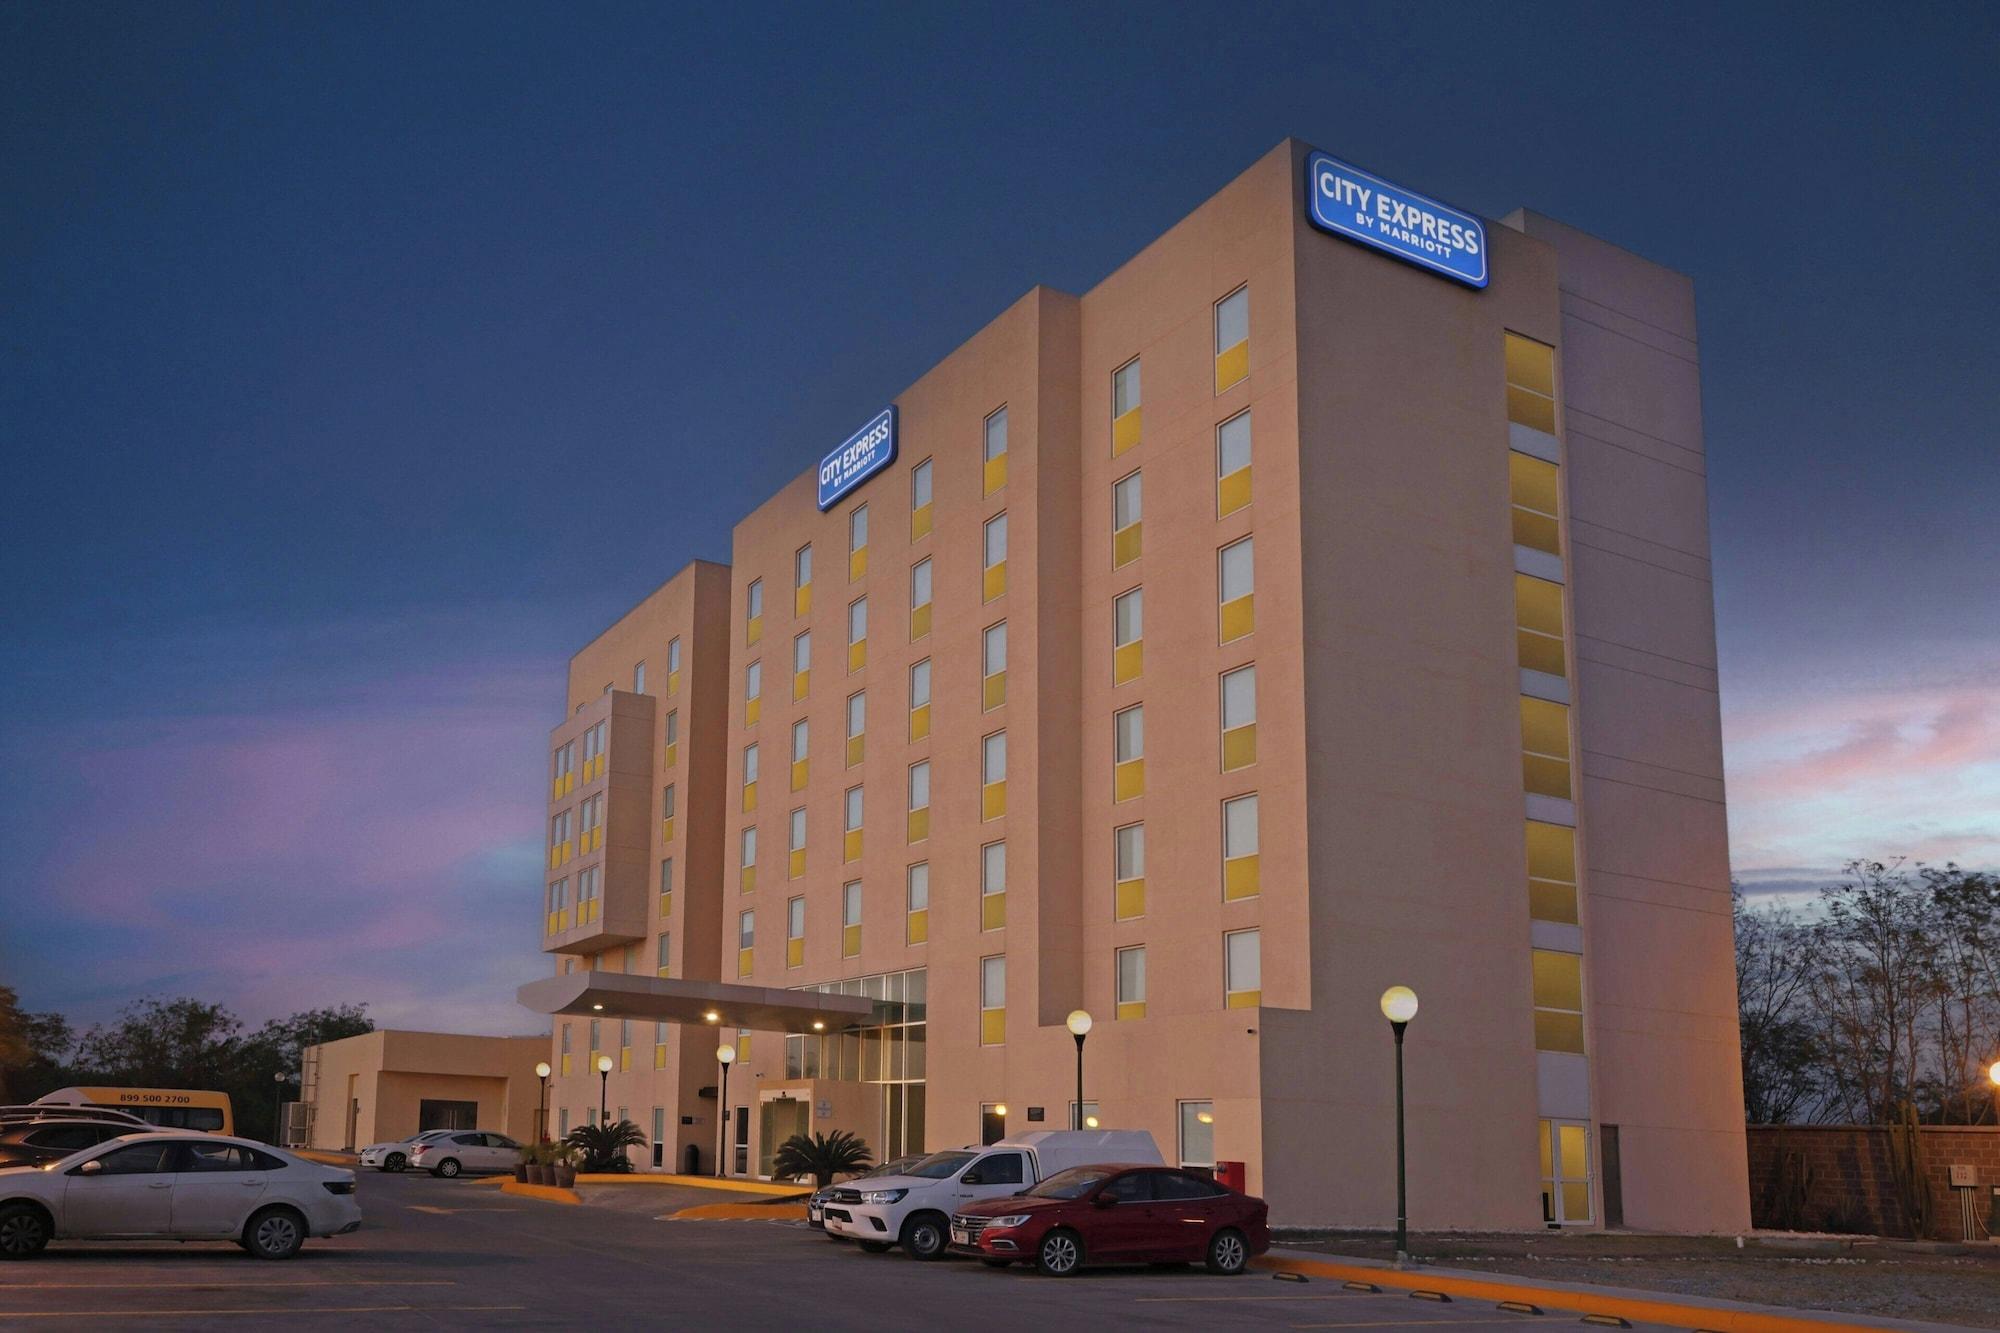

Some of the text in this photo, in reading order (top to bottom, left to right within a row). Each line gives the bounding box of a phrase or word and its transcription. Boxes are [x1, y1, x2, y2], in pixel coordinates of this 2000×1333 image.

[1320, 172, 1479, 255] CITY EXPRESS
[1356, 212, 1452, 259] BY MARRIOTT
[821, 419, 889, 485] CITY EXPRESS
[833, 450, 876, 488] BY MARRIOTT
[120, 1094, 190, 1104] 899 500 2700
